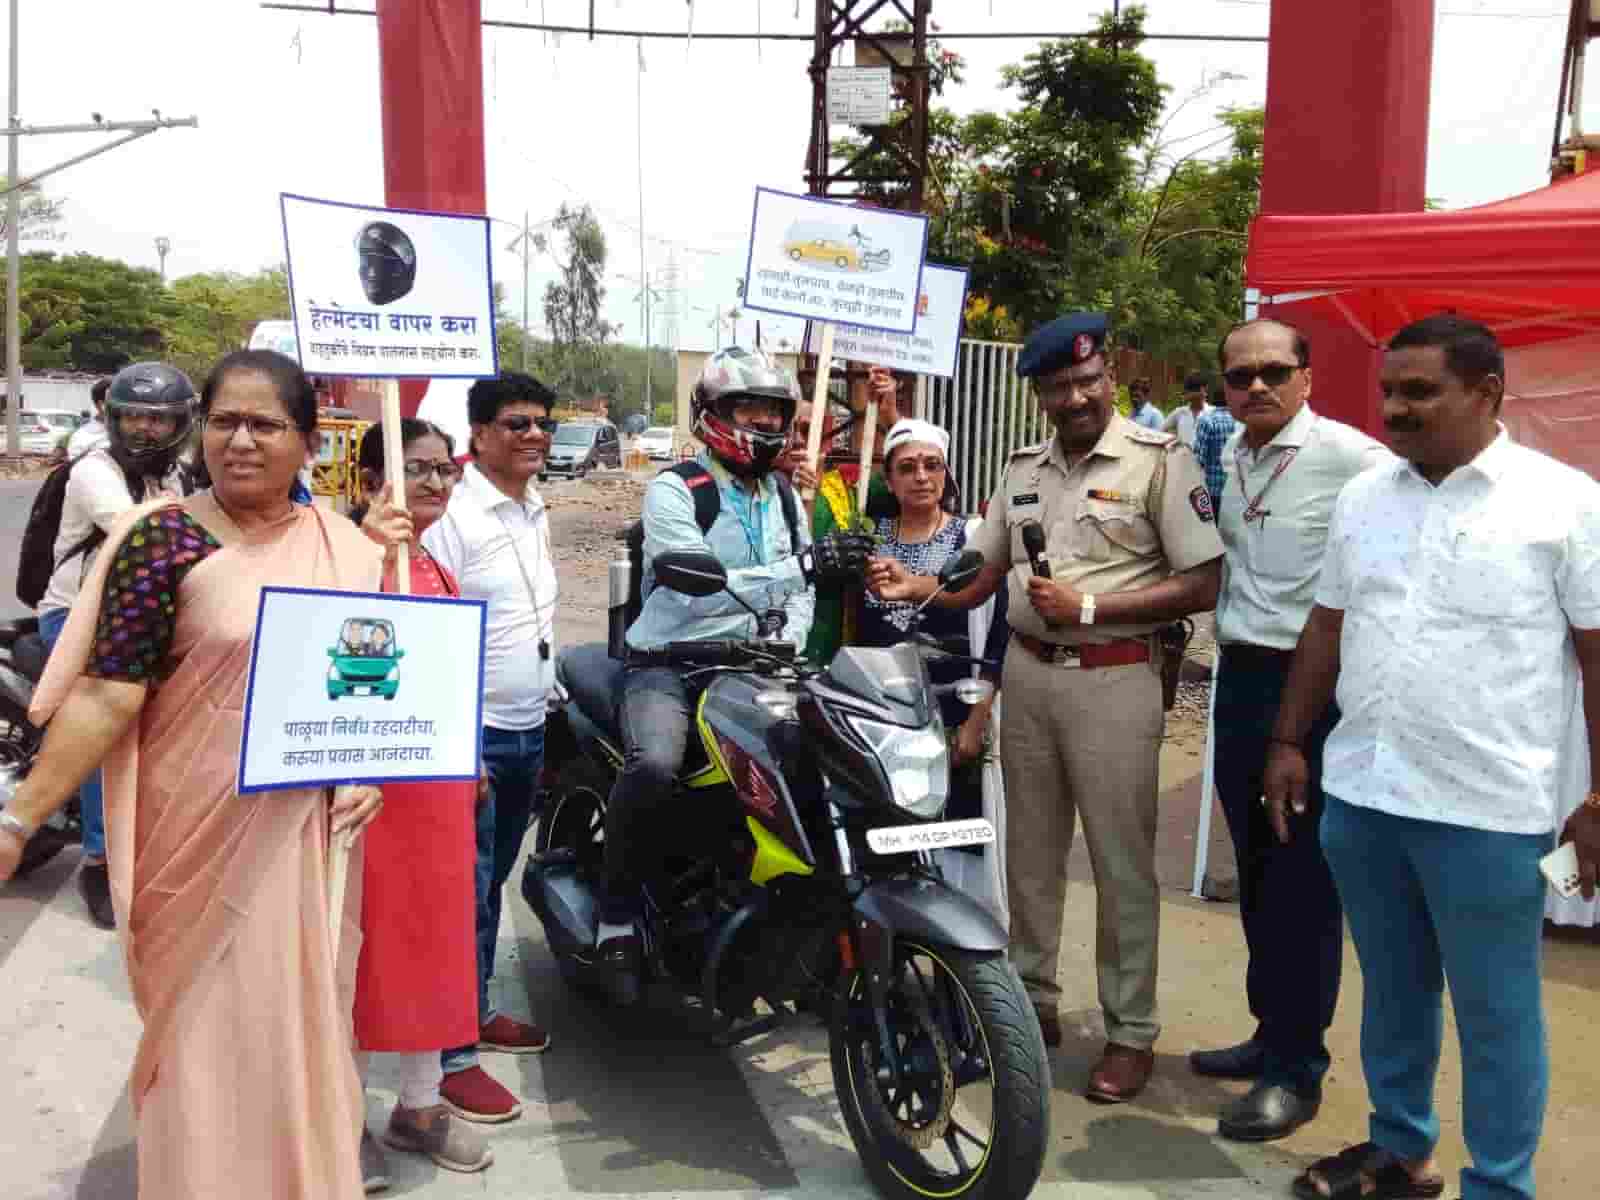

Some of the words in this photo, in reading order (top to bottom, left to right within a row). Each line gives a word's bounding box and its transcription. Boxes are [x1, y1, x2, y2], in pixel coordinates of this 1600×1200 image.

[308, 298, 380, 332] हेल्मेटचा
[387, 313, 433, 333] वापर
[439, 316, 478, 336] करा
